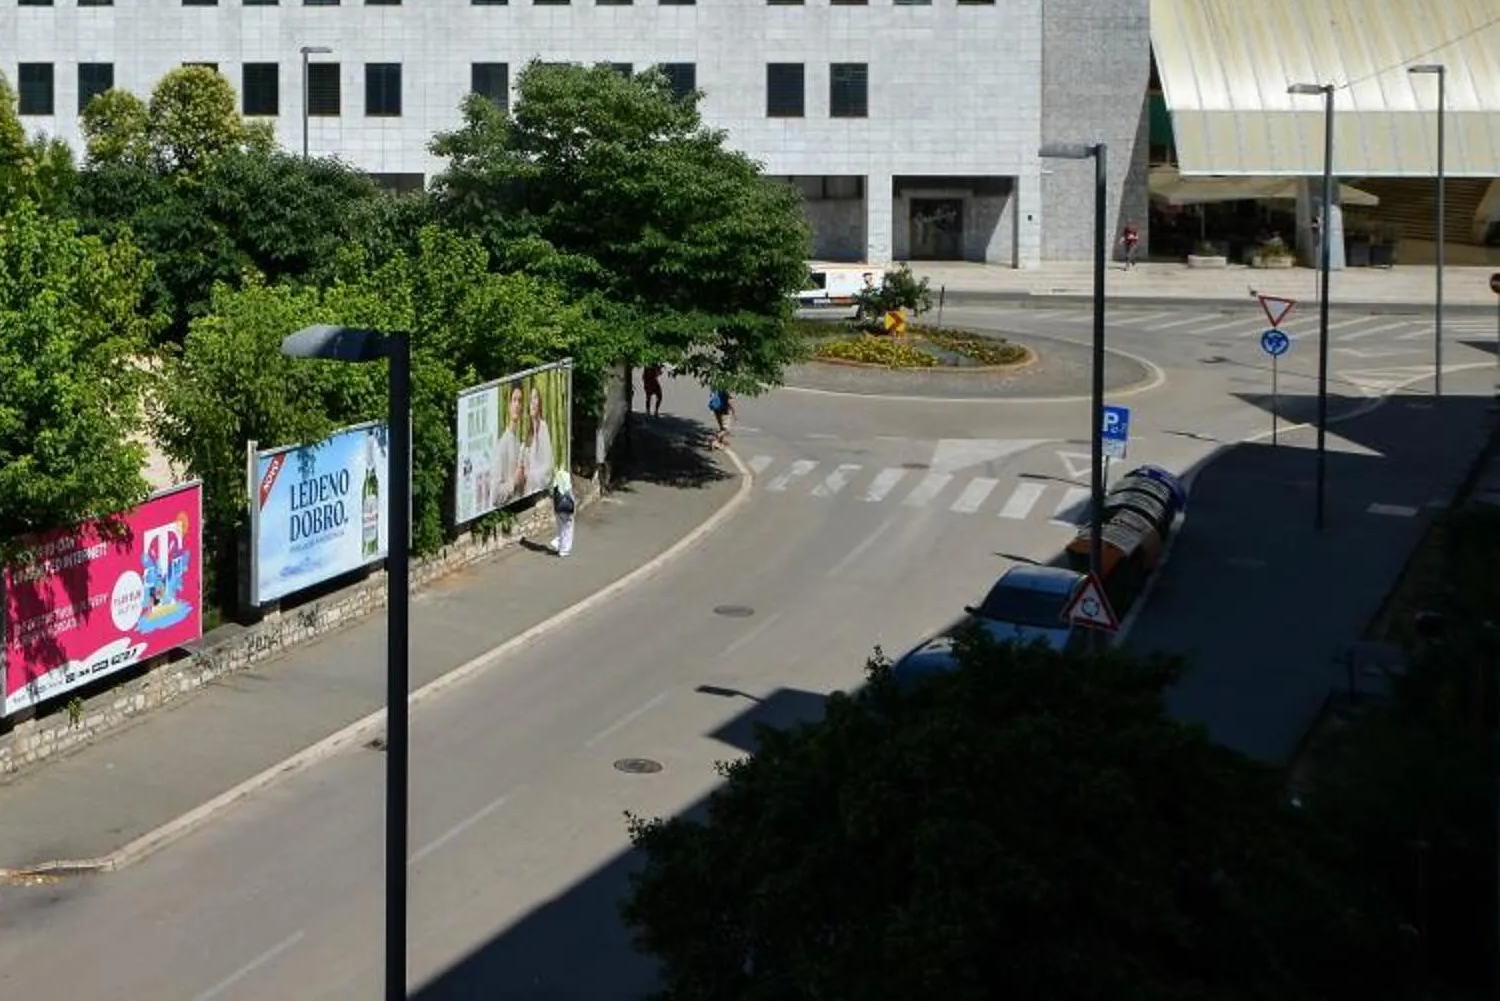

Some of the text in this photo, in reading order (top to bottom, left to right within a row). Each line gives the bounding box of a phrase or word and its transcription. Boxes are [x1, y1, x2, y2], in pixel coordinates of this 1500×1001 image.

[1103, 412, 1119, 432] P
[290, 468, 349, 511] LEDENO
[290, 500, 349, 543] DOBRO.
